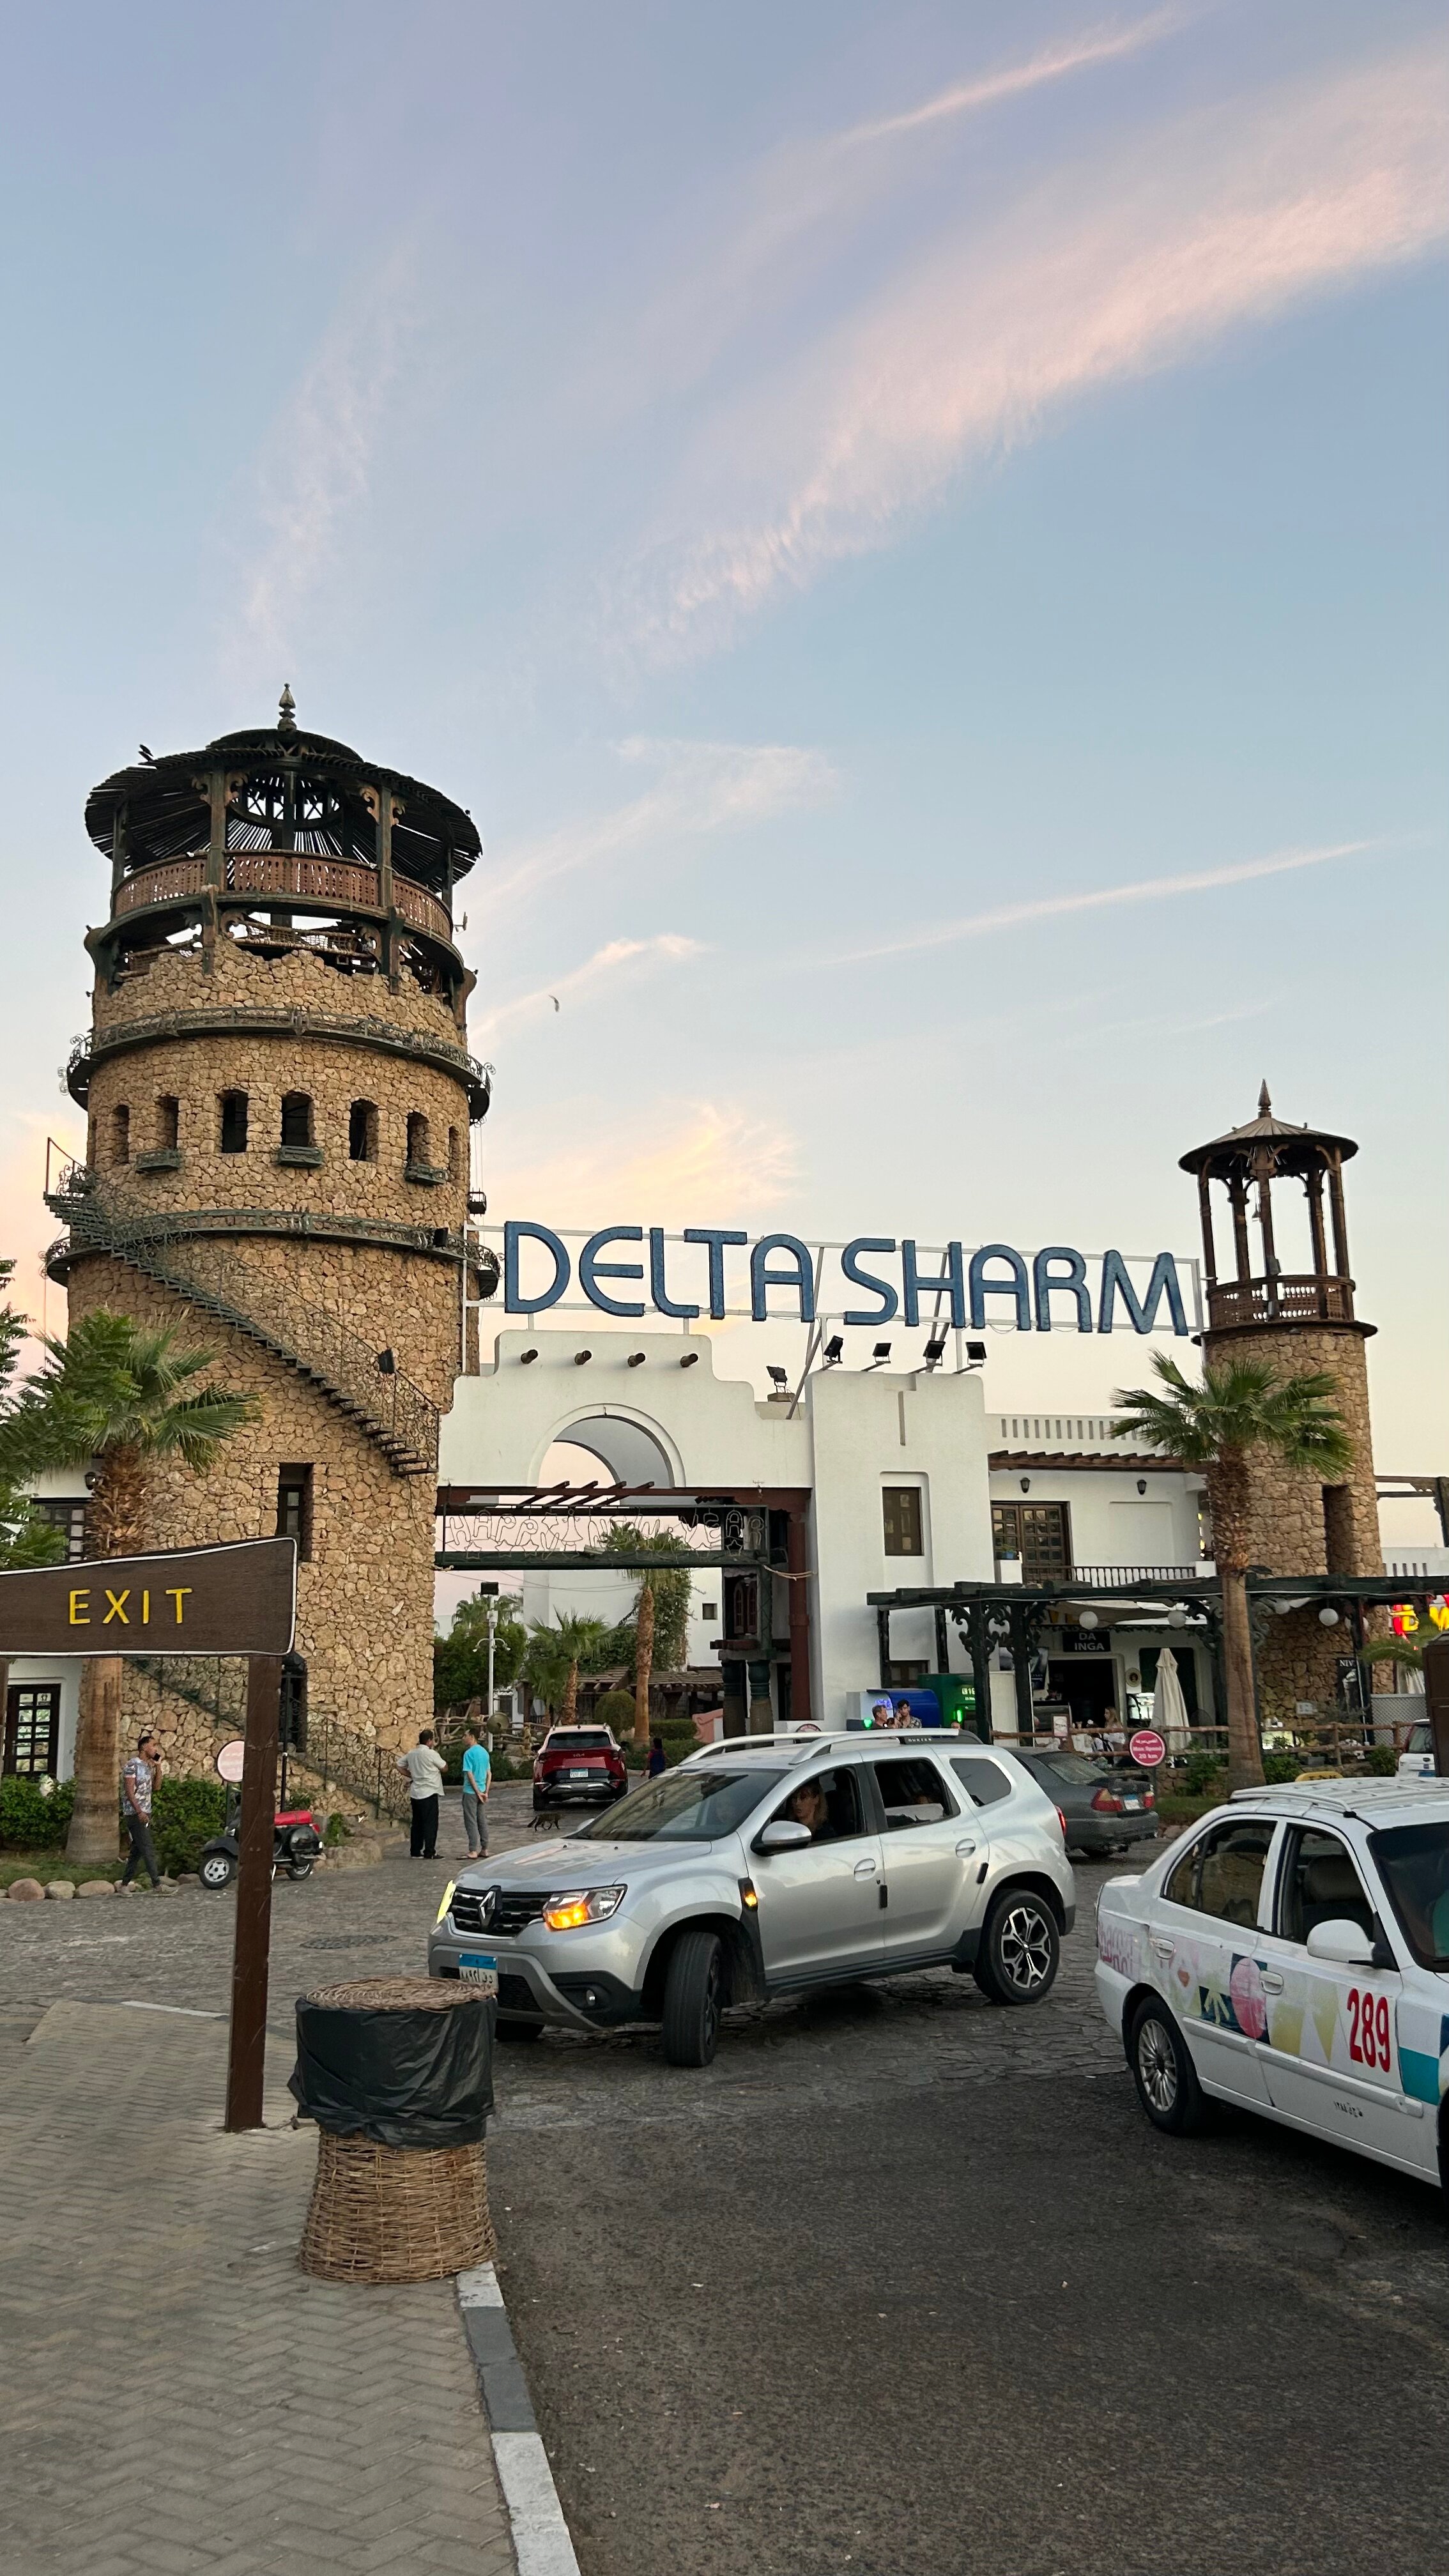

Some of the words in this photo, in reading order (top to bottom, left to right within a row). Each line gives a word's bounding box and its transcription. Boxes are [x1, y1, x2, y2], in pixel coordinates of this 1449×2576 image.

[504, 1221, 815, 1322] DELTA
[841, 1238, 1189, 1336] SHARM
[69, 1588, 192, 1625] EXIT
[1074, 1642, 1105, 1650] INGA
[1347, 1988, 1390, 2073] 289
